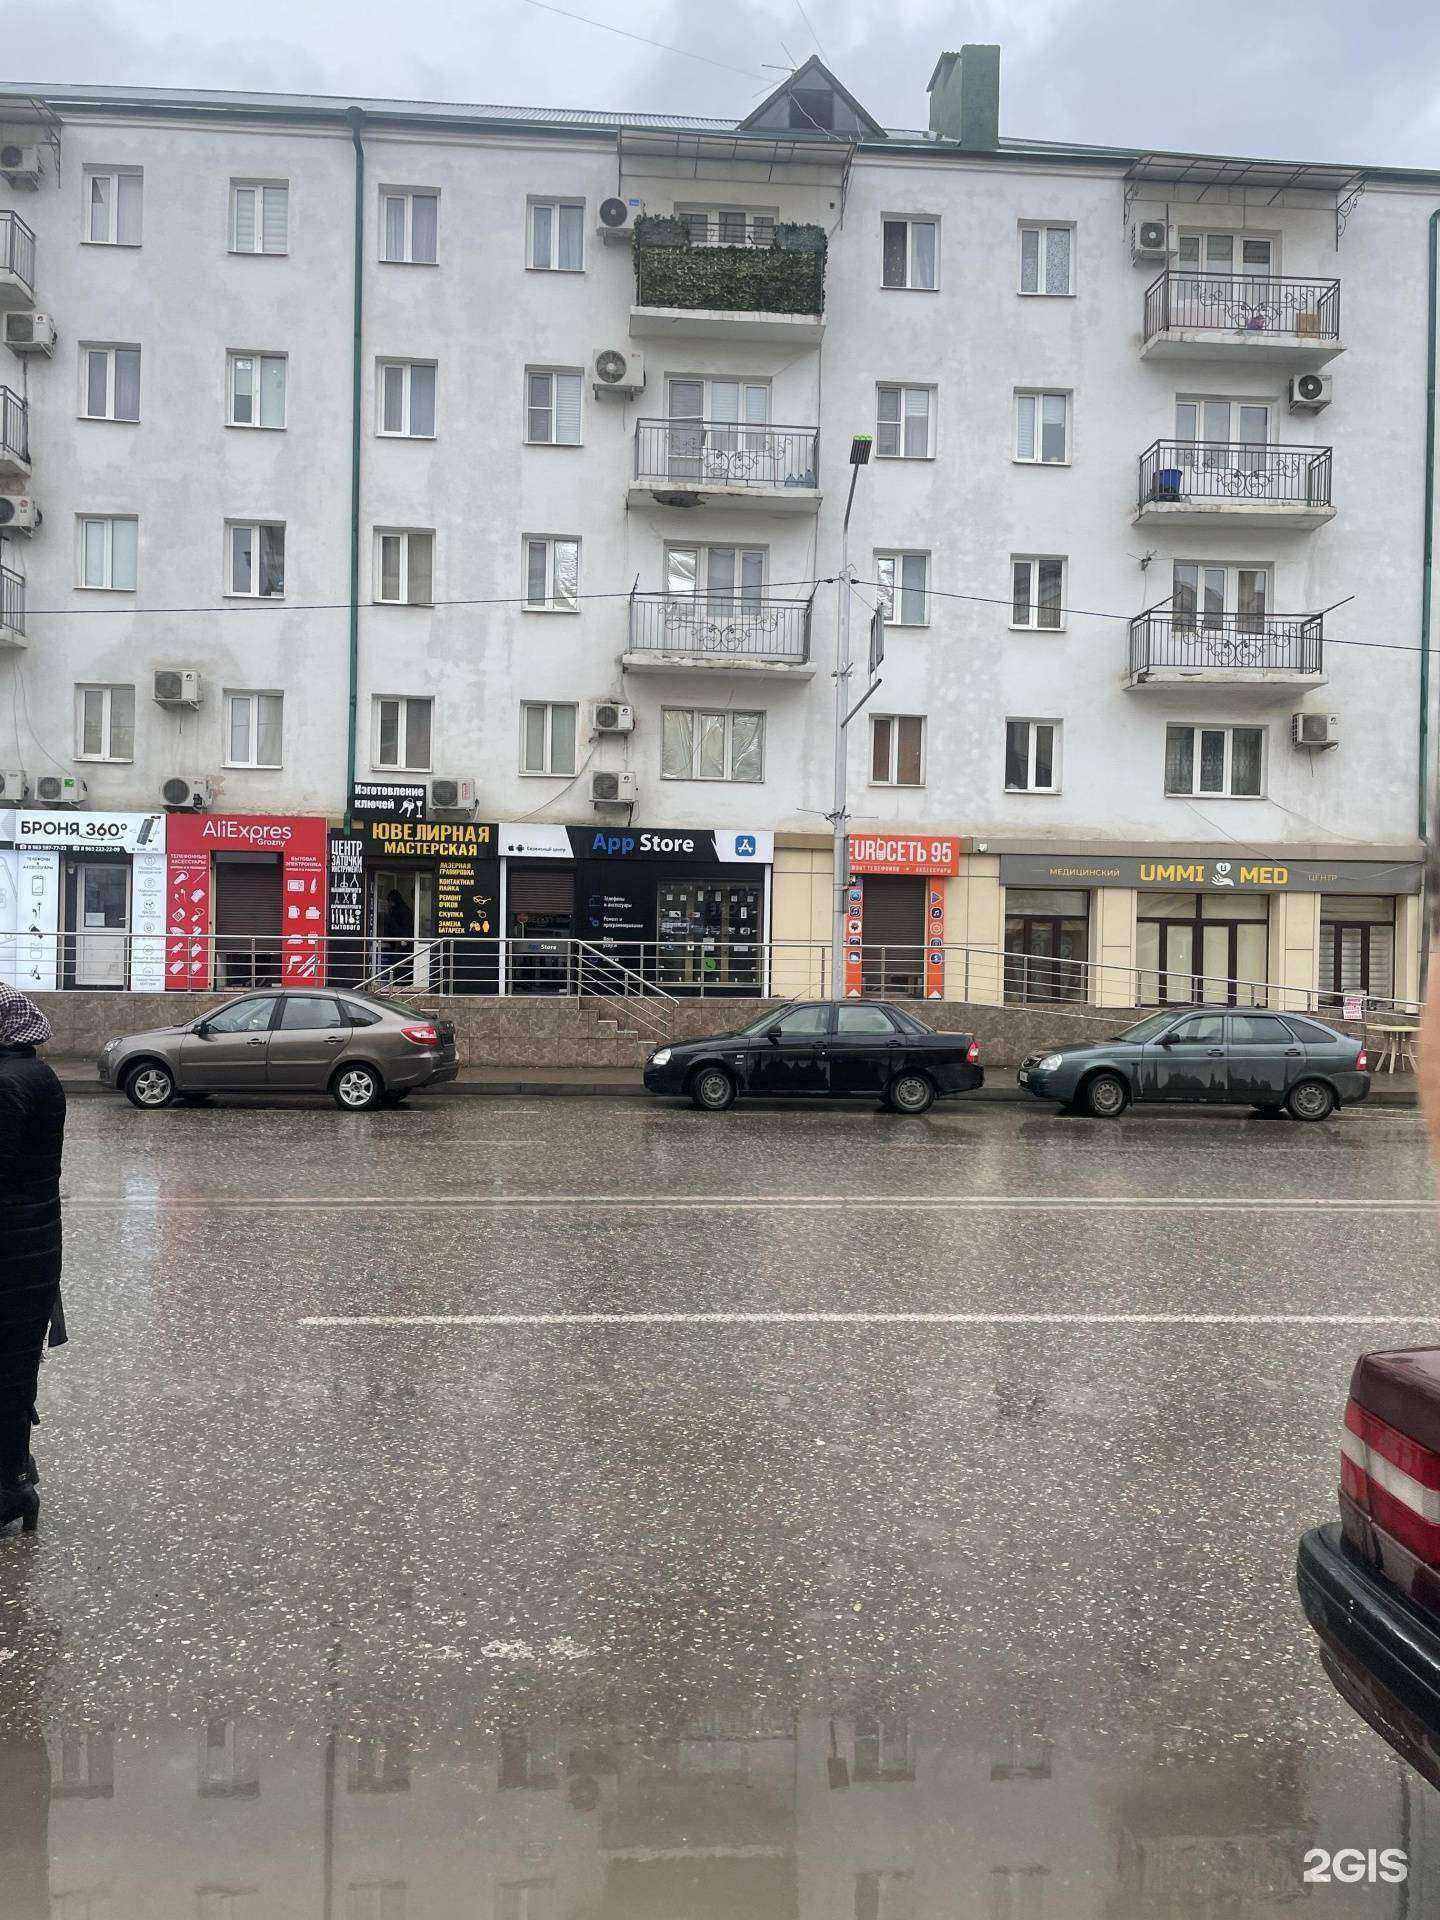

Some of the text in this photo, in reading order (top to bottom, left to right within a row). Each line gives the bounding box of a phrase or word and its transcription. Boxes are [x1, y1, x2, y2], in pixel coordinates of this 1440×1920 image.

[354, 785, 424, 797] Изготовление
[354, 798, 395, 810] ключей
[21, 821, 128, 837] БРОНЯ 360°
[202, 820, 292, 843] AliExpres
[372, 822, 490, 843] ЮВЕЛИРНАЯ
[257, 839, 286, 848] Grozny
[331, 840, 363, 856] ЦЕНТР
[384, 841, 478, 856] МАСТЕРСКАЯ
[592, 832, 694, 854] App Store
[931, 842, 952, 863] 95
[331, 855, 363, 867] ЗАТОЧКИ
[440, 868, 475, 876] ГРАВИРОВКА
[1050, 867, 1120, 877] МЕДИЦИНСКИЙ
[1140, 864, 1288, 885] UMMI MED
[1308, 872, 1338, 882] ЦЕНТР
